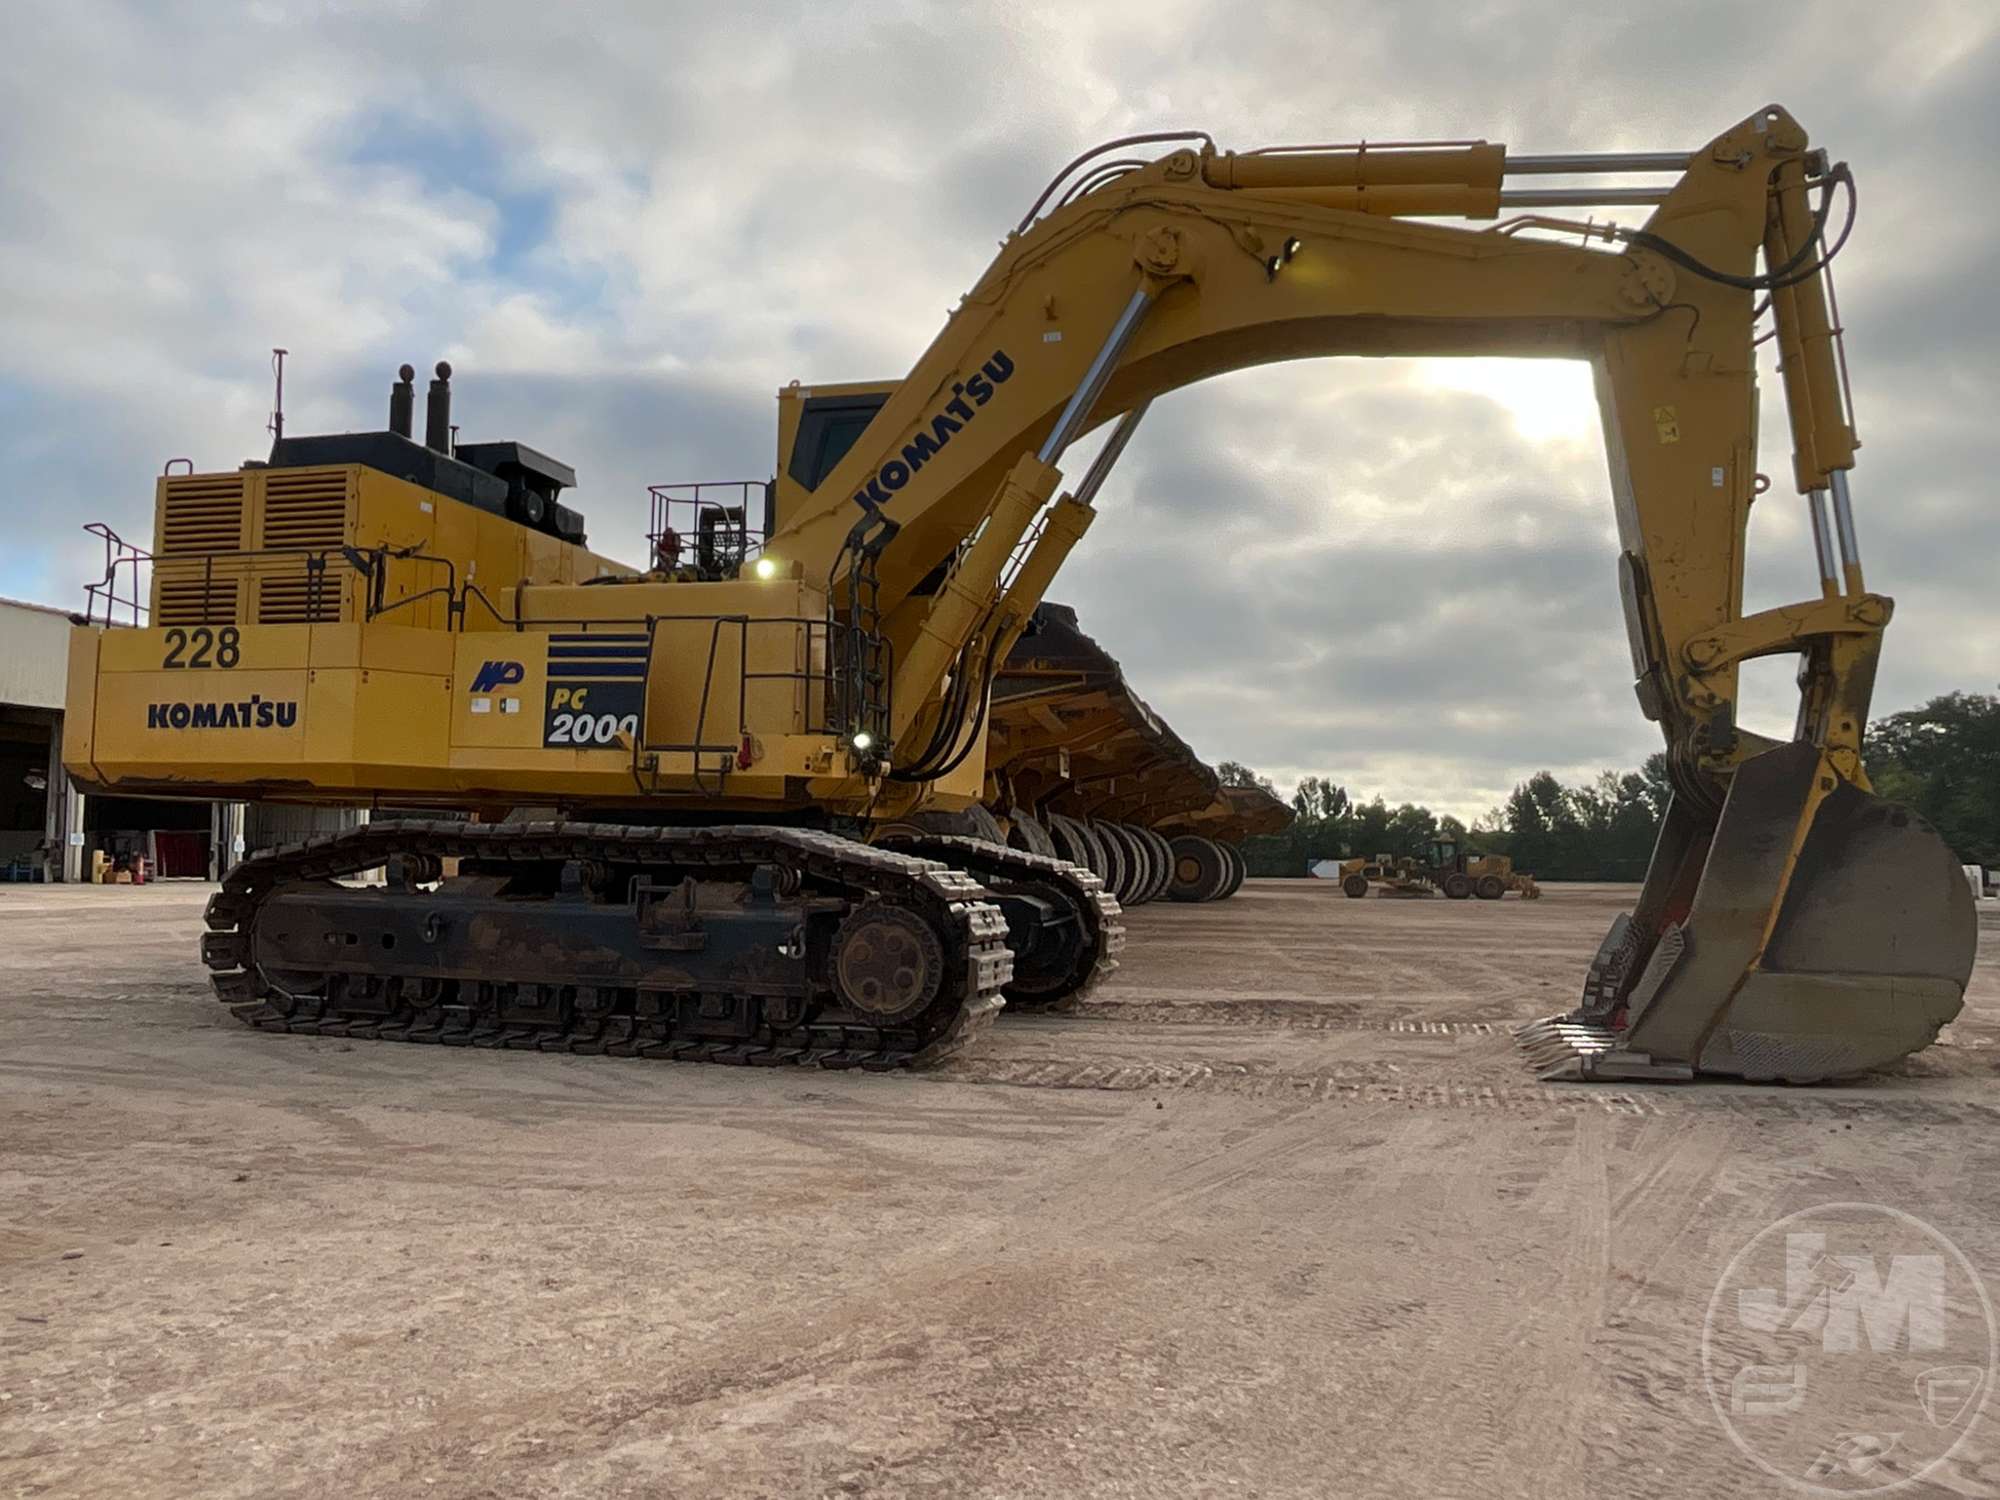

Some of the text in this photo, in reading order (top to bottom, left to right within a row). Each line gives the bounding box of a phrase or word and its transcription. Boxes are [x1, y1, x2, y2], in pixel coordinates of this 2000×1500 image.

[853, 350, 1014, 513] KOMATSU
[163, 627, 240, 669] 228
[147, 694, 297, 729] KOMATSU
[551, 688, 588, 710] PC
